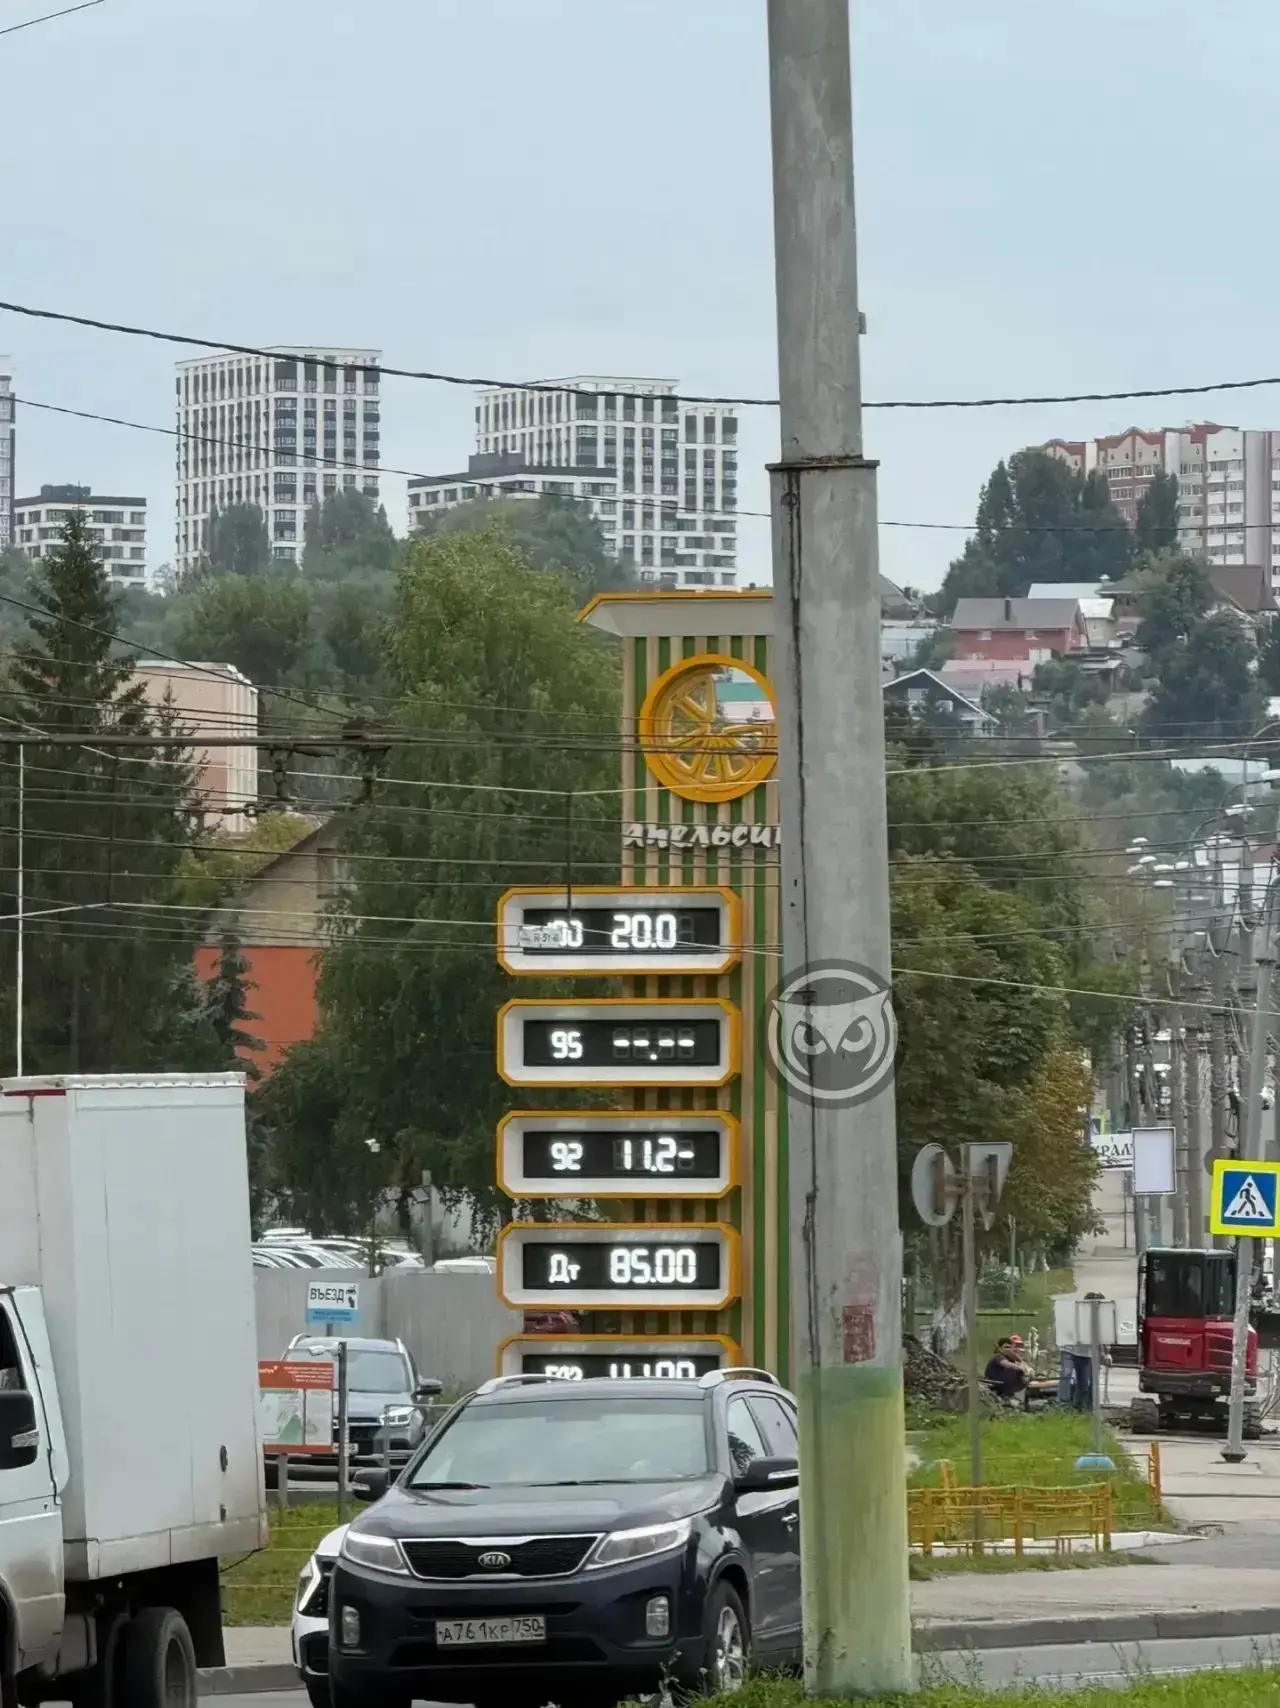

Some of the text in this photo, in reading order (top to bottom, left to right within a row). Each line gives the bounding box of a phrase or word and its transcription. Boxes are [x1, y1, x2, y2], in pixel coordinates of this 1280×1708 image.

[611, 913, 677, 949] 20.0
[550, 1030, 584, 1060] 95
[549, 1142, 584, 1171] 92
[548, 1247, 697, 1284] Дт 85.00
[310, 1287, 345, 1304] ВЪЕЗД
[483, 1555, 505, 1565] KIA
[514, 1618, 540, 1634] 750
